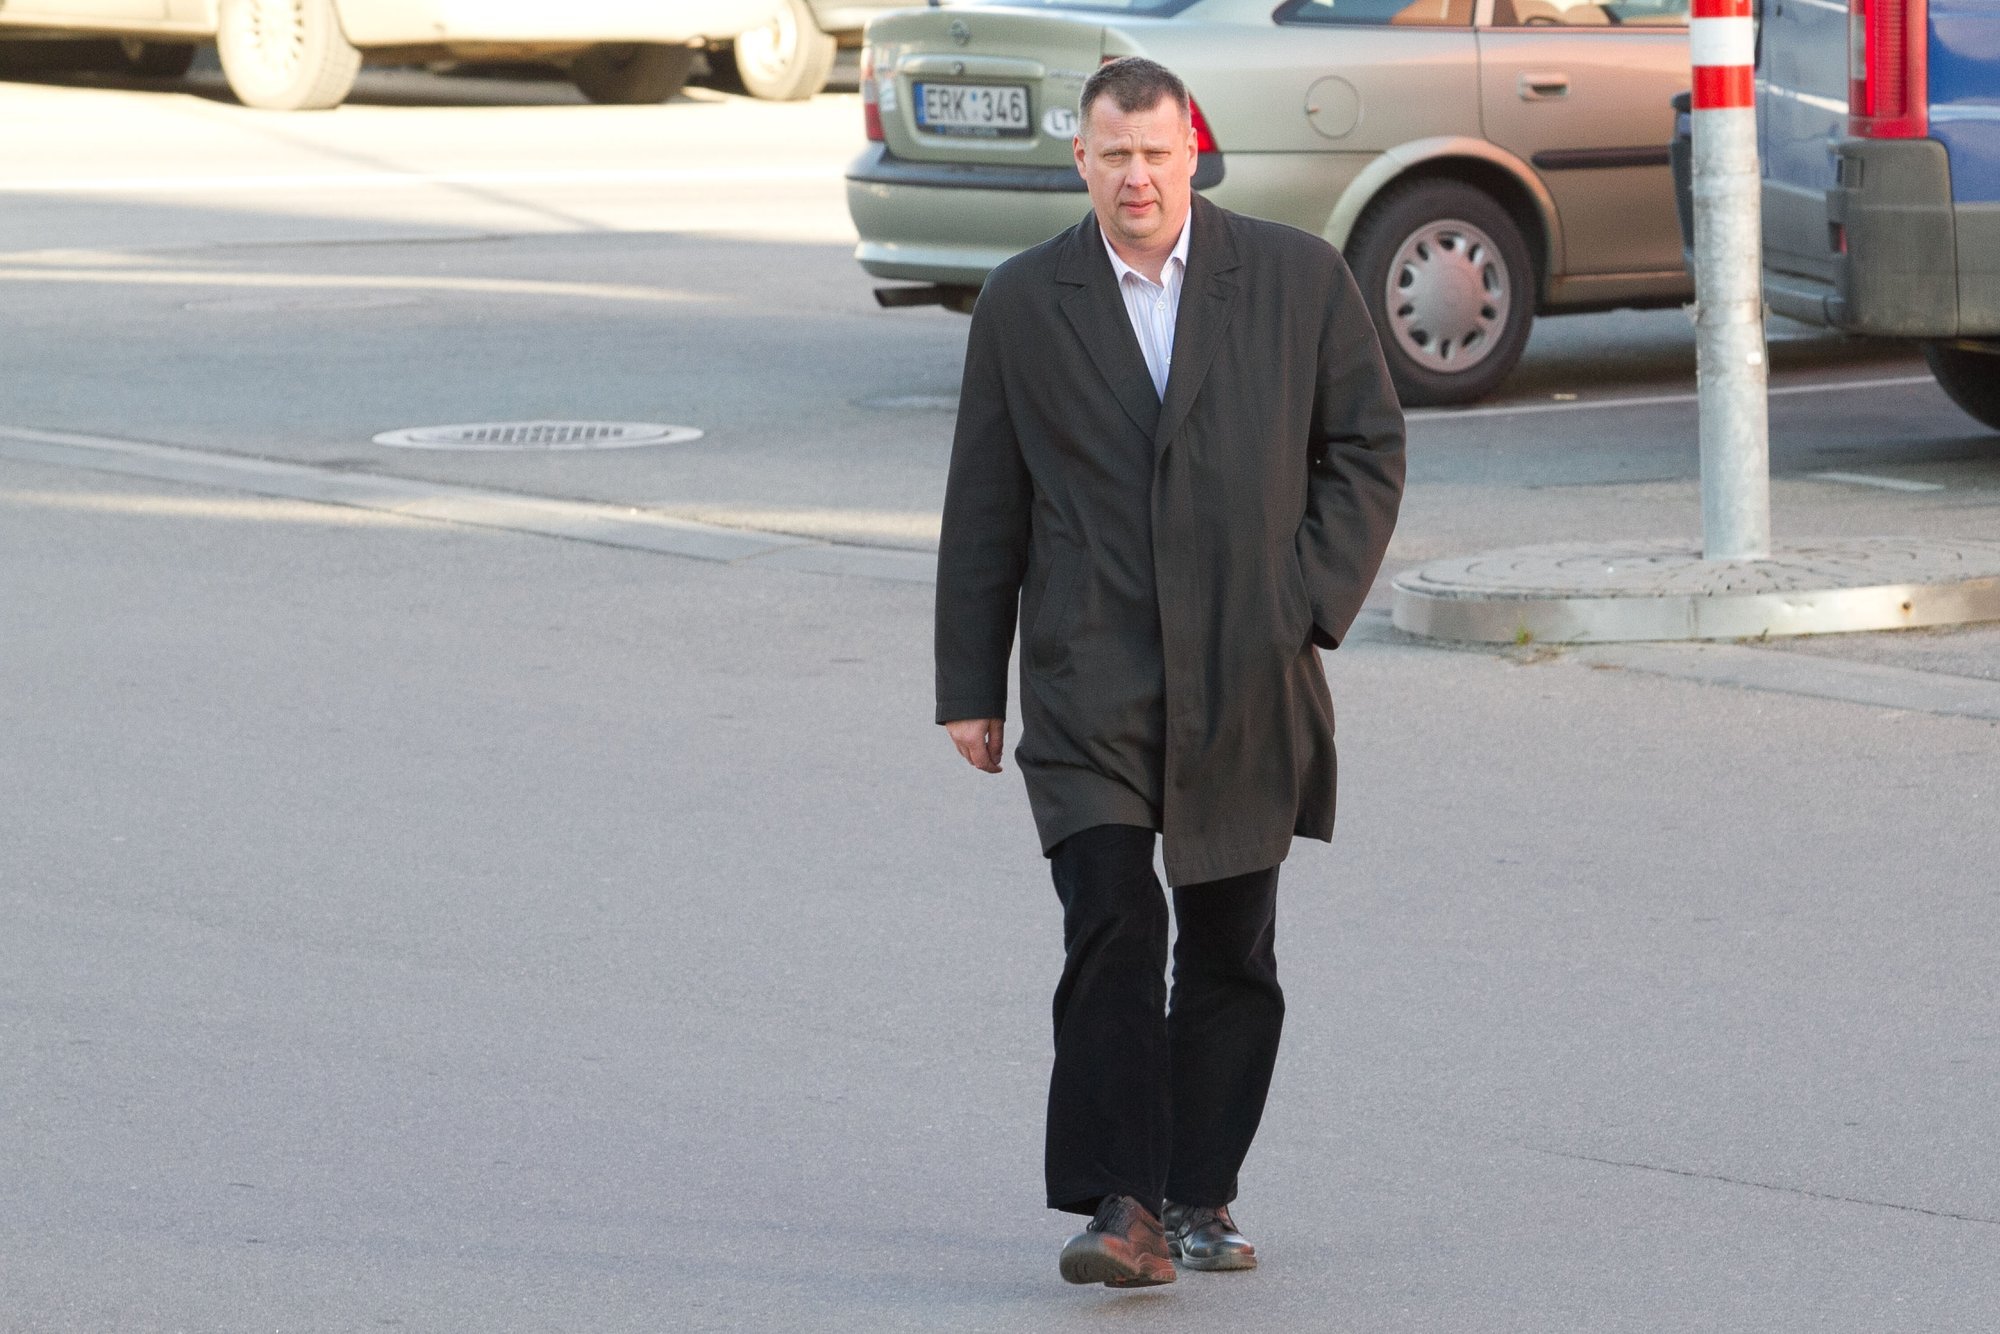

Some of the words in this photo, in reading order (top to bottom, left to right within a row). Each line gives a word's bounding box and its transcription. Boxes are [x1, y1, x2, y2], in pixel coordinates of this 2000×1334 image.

[926, 87, 967, 120] ERK
[982, 90, 1022, 122] 346
[1051, 110, 1073, 131] LT
